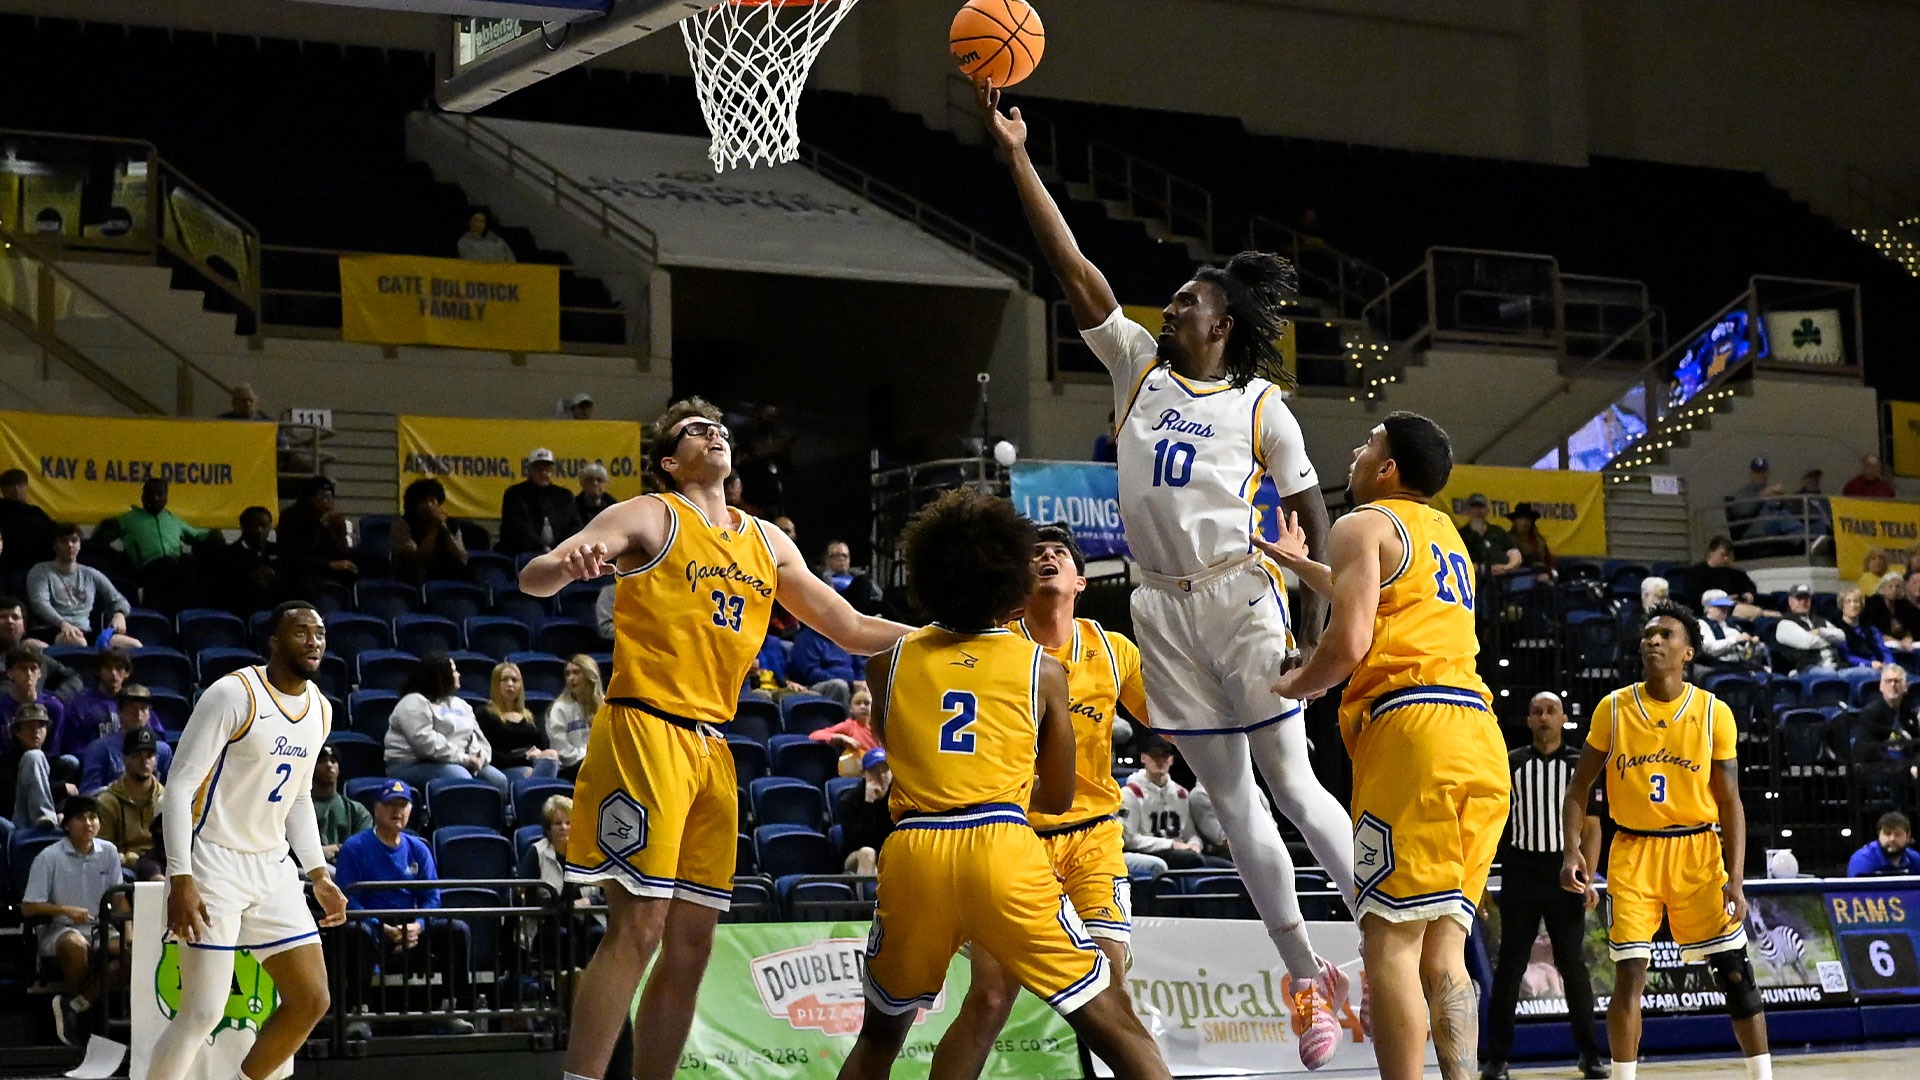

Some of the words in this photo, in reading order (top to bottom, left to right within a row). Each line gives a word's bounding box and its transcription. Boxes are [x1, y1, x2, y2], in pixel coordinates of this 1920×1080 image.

[377, 275, 423, 294] CATE
[420, 298, 486, 321] FAMILY
[299, 412, 324, 426] 111
[1151, 408, 1215, 438] Rams
[40, 456, 77, 480] KAY
[84, 459, 97, 481] &
[104, 460, 154, 484] ALEX
[161, 463, 233, 485] DECUIR
[403, 452, 515, 479] ARMSTRONG,
[610, 456, 638, 477] CO.
[1152, 438, 1197, 487] 10
[1025, 495, 1120, 528] LEADING
[685, 560, 773, 599] Javelinas
[1431, 543, 1475, 611] 20
[711, 589, 745, 632] 33
[938, 688, 979, 755] 2
[269, 735, 309, 758] Rams
[1616, 748, 1701, 781] Javelinas
[267, 763, 292, 803] 2
[1648, 773, 1667, 804] 3
[1149, 810, 1181, 839] 10
[1832, 897, 1906, 925] RAMS
[1868, 940, 1896, 978] 6
[1128, 967, 1286, 1030] ropical
[1202, 1021, 1290, 1045] SMOOTHIE
